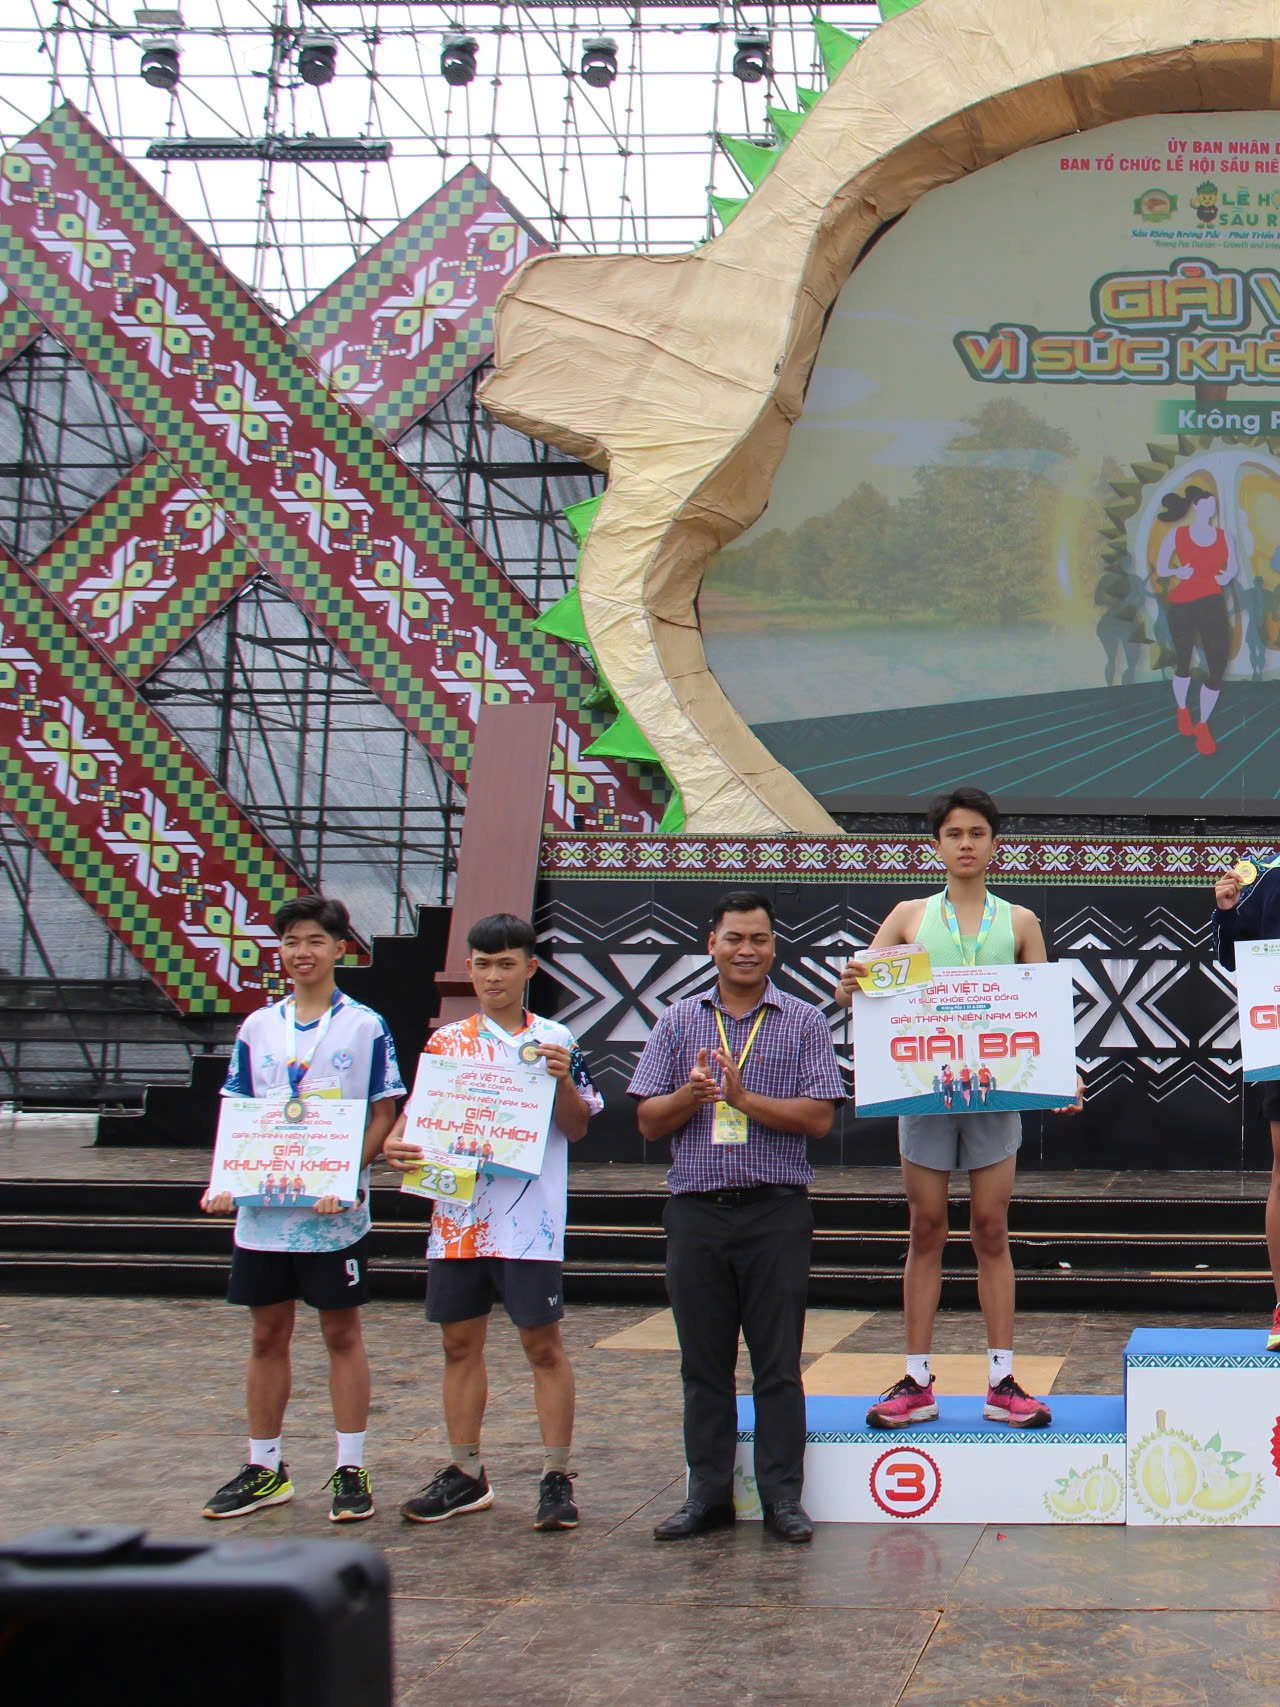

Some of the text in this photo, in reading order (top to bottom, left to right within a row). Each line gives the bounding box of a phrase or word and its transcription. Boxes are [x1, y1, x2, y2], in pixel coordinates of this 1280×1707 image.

[1193, 141, 1223, 154] BAN
[1228, 139, 1270, 155] NHÂN
[1060, 158, 1090, 171] BAN
[1095, 153, 1114, 171] TỔ
[1119, 155, 1161, 171] CHỨC
[1189, 156, 1215, 175] HỘI
[1101, 264, 1234, 320] GIẢI
[960, 327, 1018, 372] VÌ
[1031, 330, 1164, 373] SỨC
[1178, 408, 1260, 434] Krông
[871, 958, 911, 988] 37
[926, 982, 948, 995] GIẢI
[952, 980, 978, 996] VIỆT
[966, 994, 992, 1004] CỘNG
[890, 1010, 1038, 1025] GIẢI THANH NIÊN NAM 5KM
[890, 1027, 1040, 1062] GIẢI BA
[480, 1072, 498, 1084] VIỆT
[446, 1092, 476, 1102] THANH
[499, 1098, 519, 1108] NAM
[465, 1106, 496, 1123] GIẢI
[490, 1125, 538, 1143] KHÍCH
[272, 1142, 305, 1157] GIẢI
[300, 1157, 350, 1172] KHÍCH
[420, 1164, 458, 1195] 28
[345, 1258, 360, 1287] 9
[885, 1463, 926, 1502] 3
